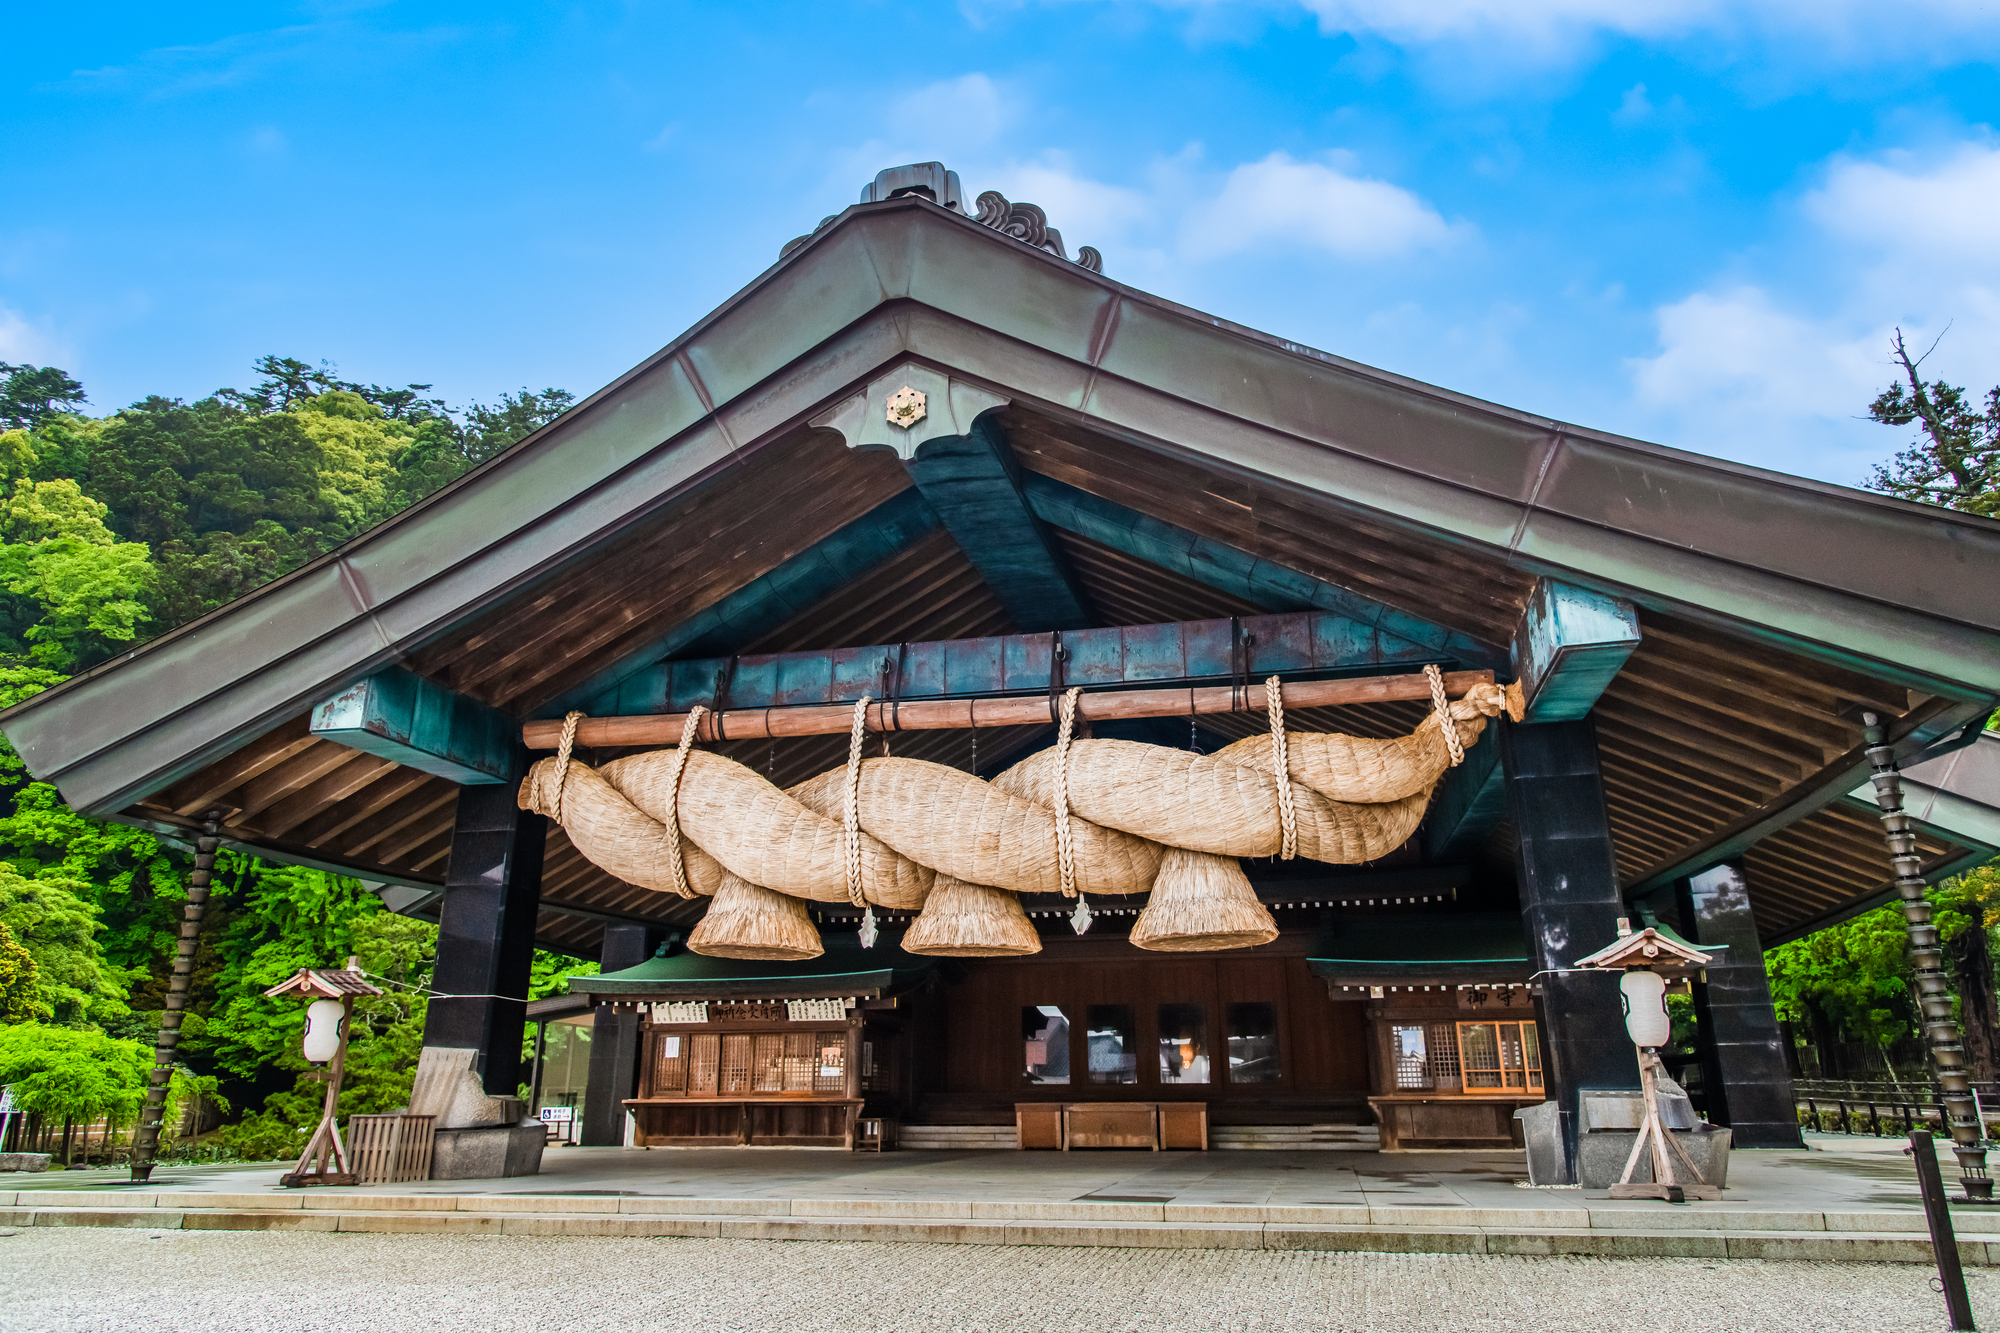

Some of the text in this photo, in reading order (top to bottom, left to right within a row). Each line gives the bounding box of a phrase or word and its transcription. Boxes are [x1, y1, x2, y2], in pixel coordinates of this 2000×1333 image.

[711, 1004, 782, 1020] 御祈念受付所
